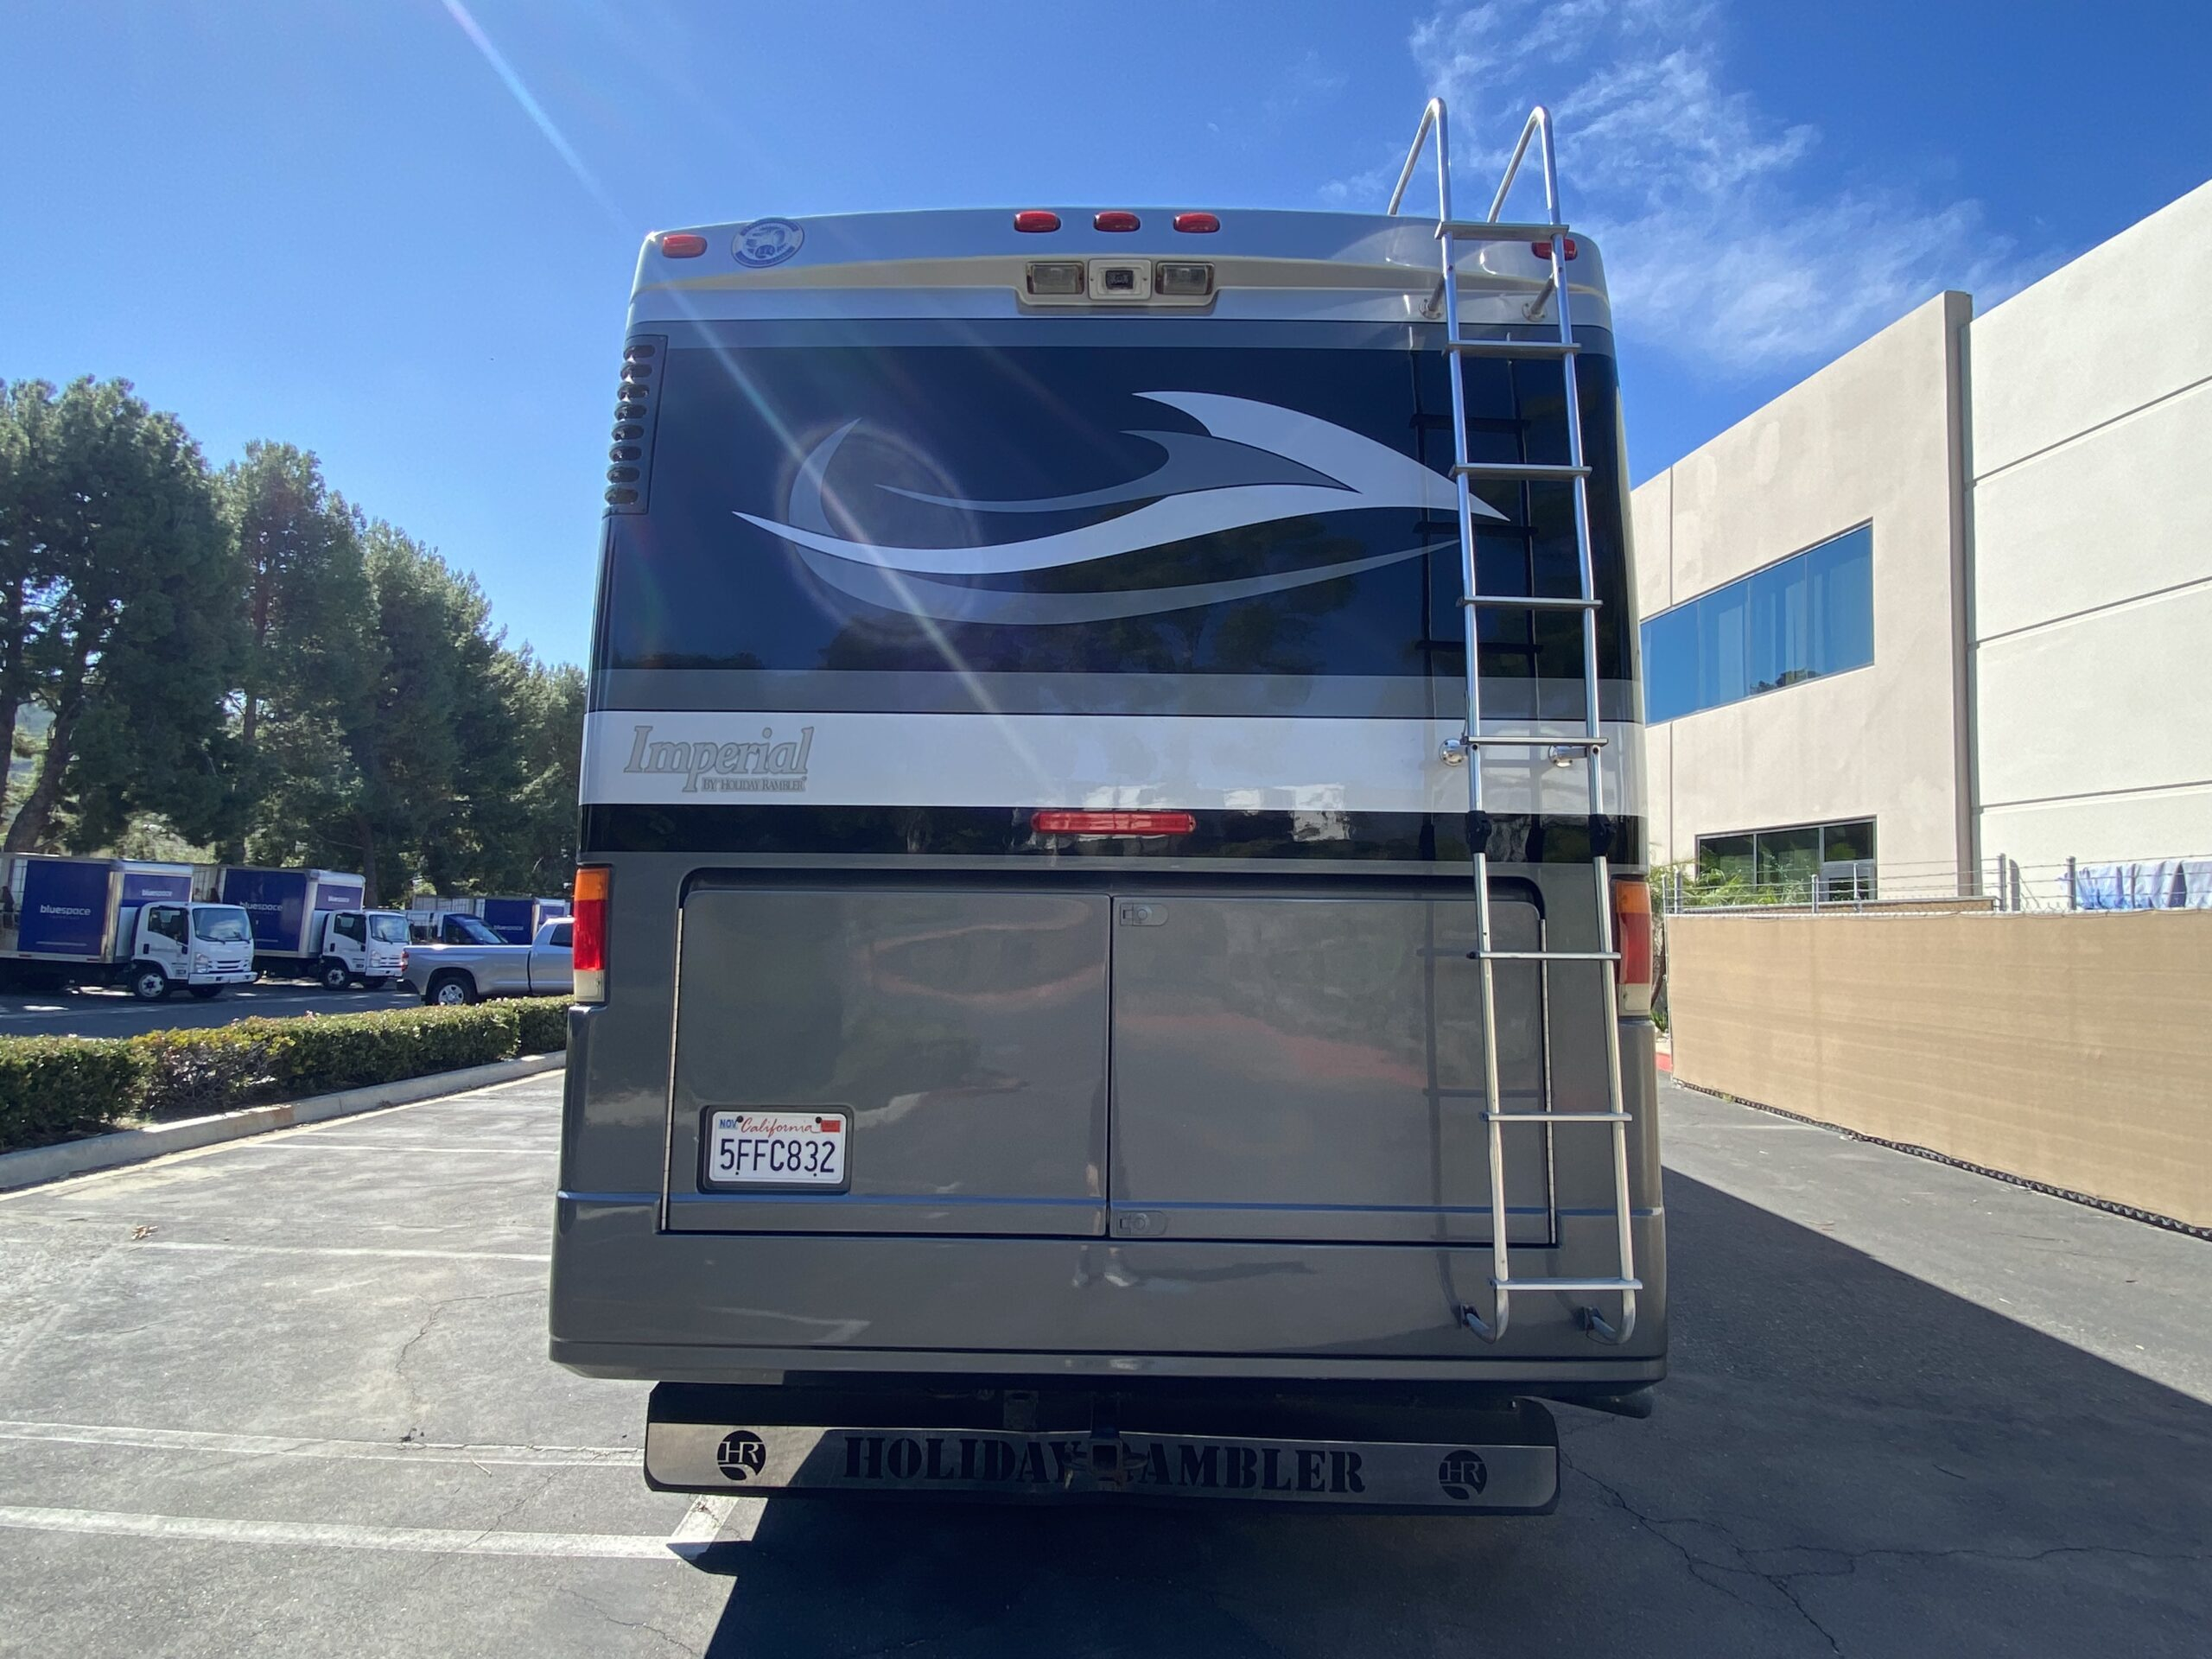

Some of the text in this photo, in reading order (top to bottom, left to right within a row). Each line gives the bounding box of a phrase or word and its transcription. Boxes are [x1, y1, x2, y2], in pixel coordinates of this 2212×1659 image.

[623, 725, 814, 792] Imperial
[703, 779, 716, 791] BY
[721, 778, 760, 791] HOLIDAY
[40, 904, 92, 916] bluespace
[741, 1116, 821, 1138] California
[720, 1138, 836, 1173] 5FFC832
[1098, 1442, 1366, 1493] AMBLER
